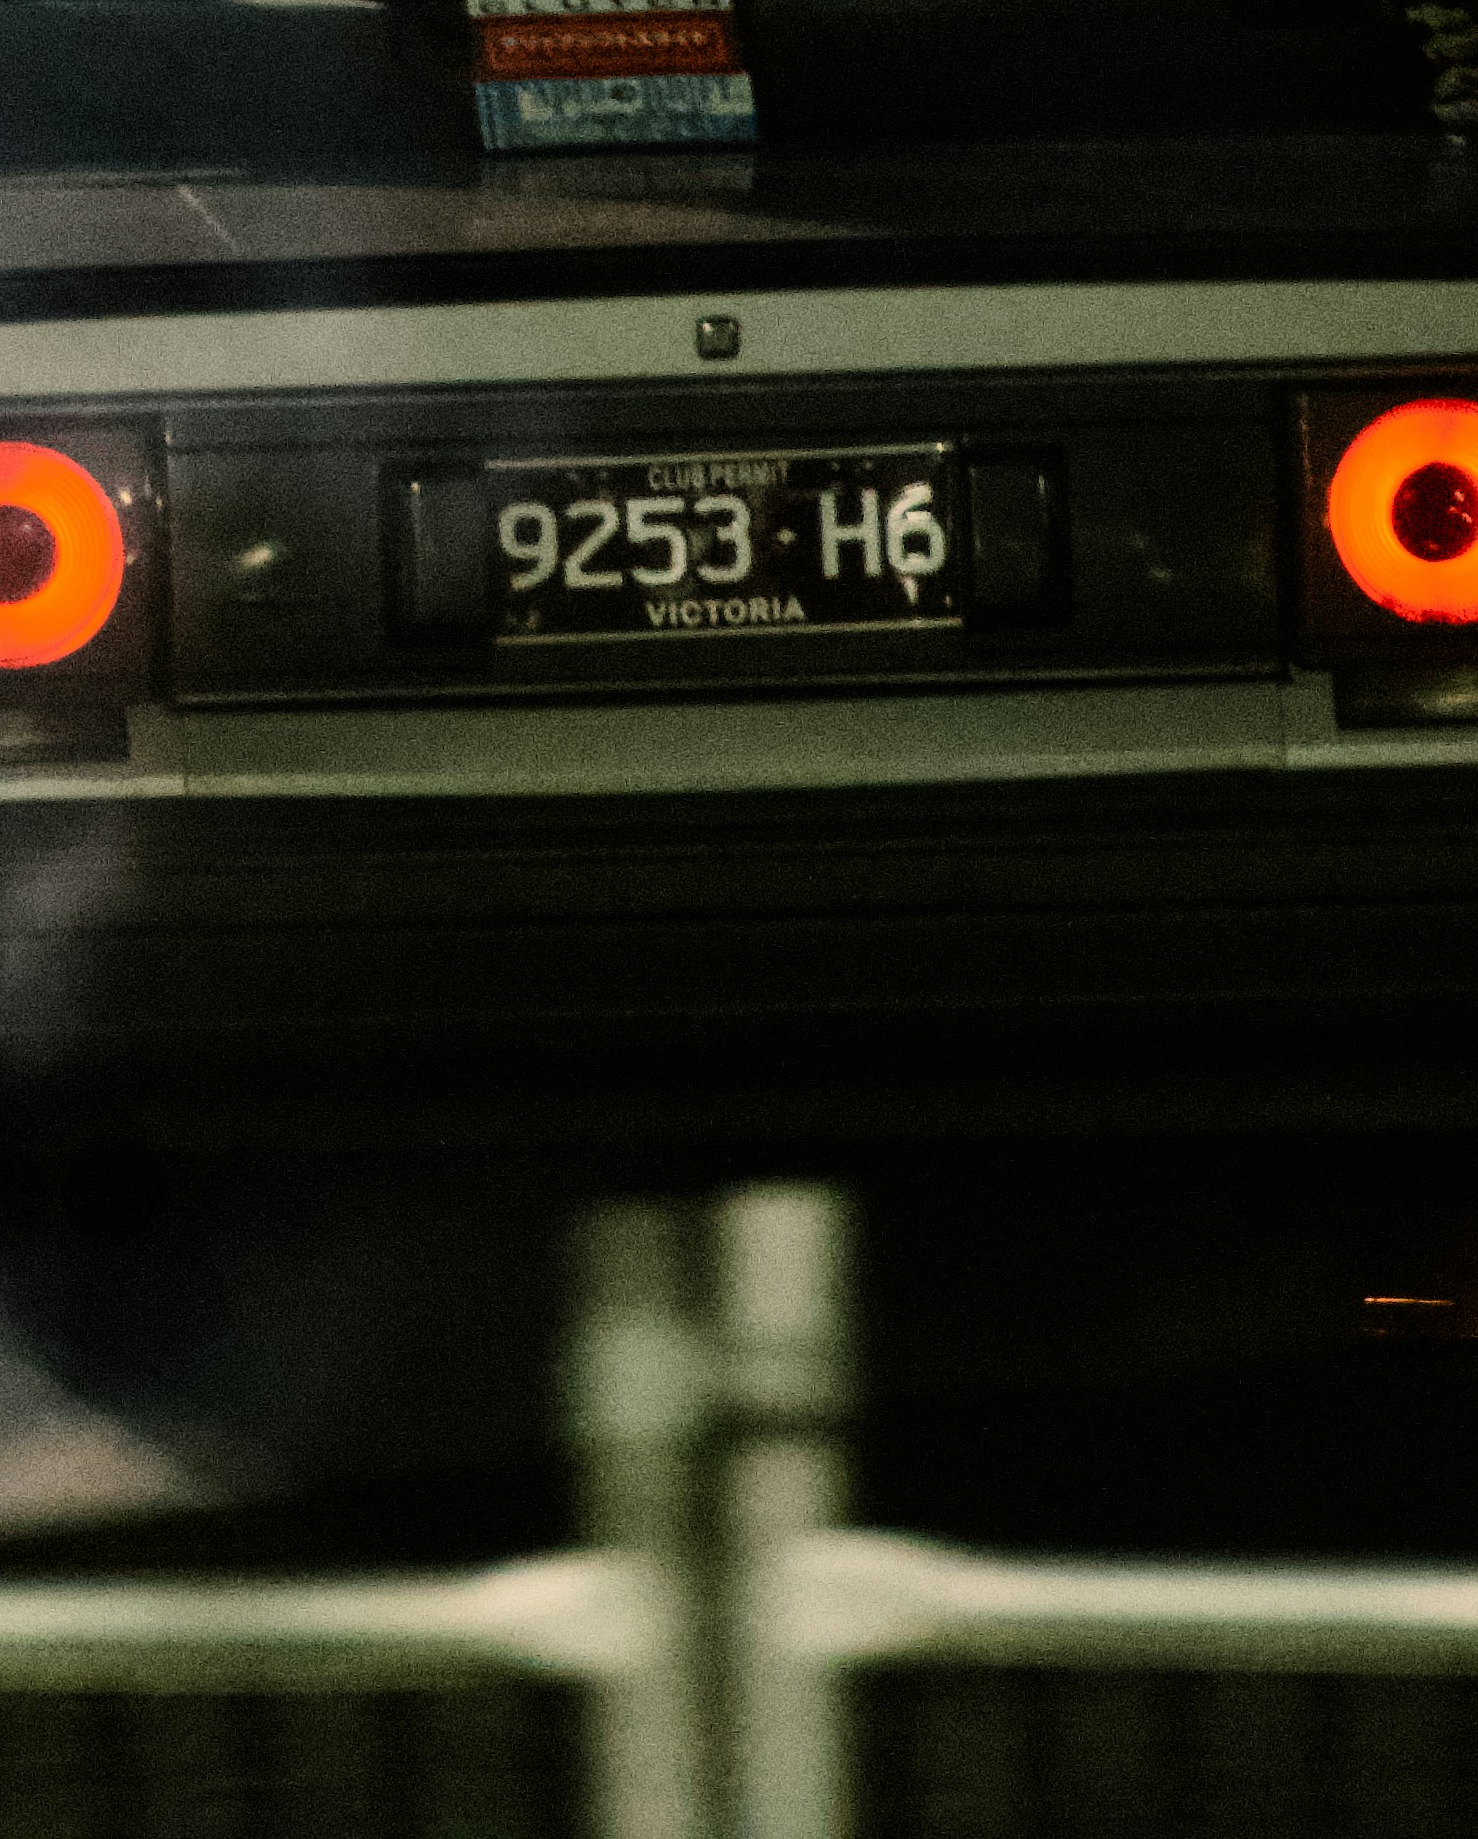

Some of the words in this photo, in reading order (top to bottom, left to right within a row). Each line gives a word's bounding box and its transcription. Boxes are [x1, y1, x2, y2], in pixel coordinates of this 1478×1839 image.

[647, 464, 706, 491] CLUB
[498, 494, 752, 592] 9253
[819, 482, 946, 579] H6
[646, 594, 807, 628] VICTORIA
